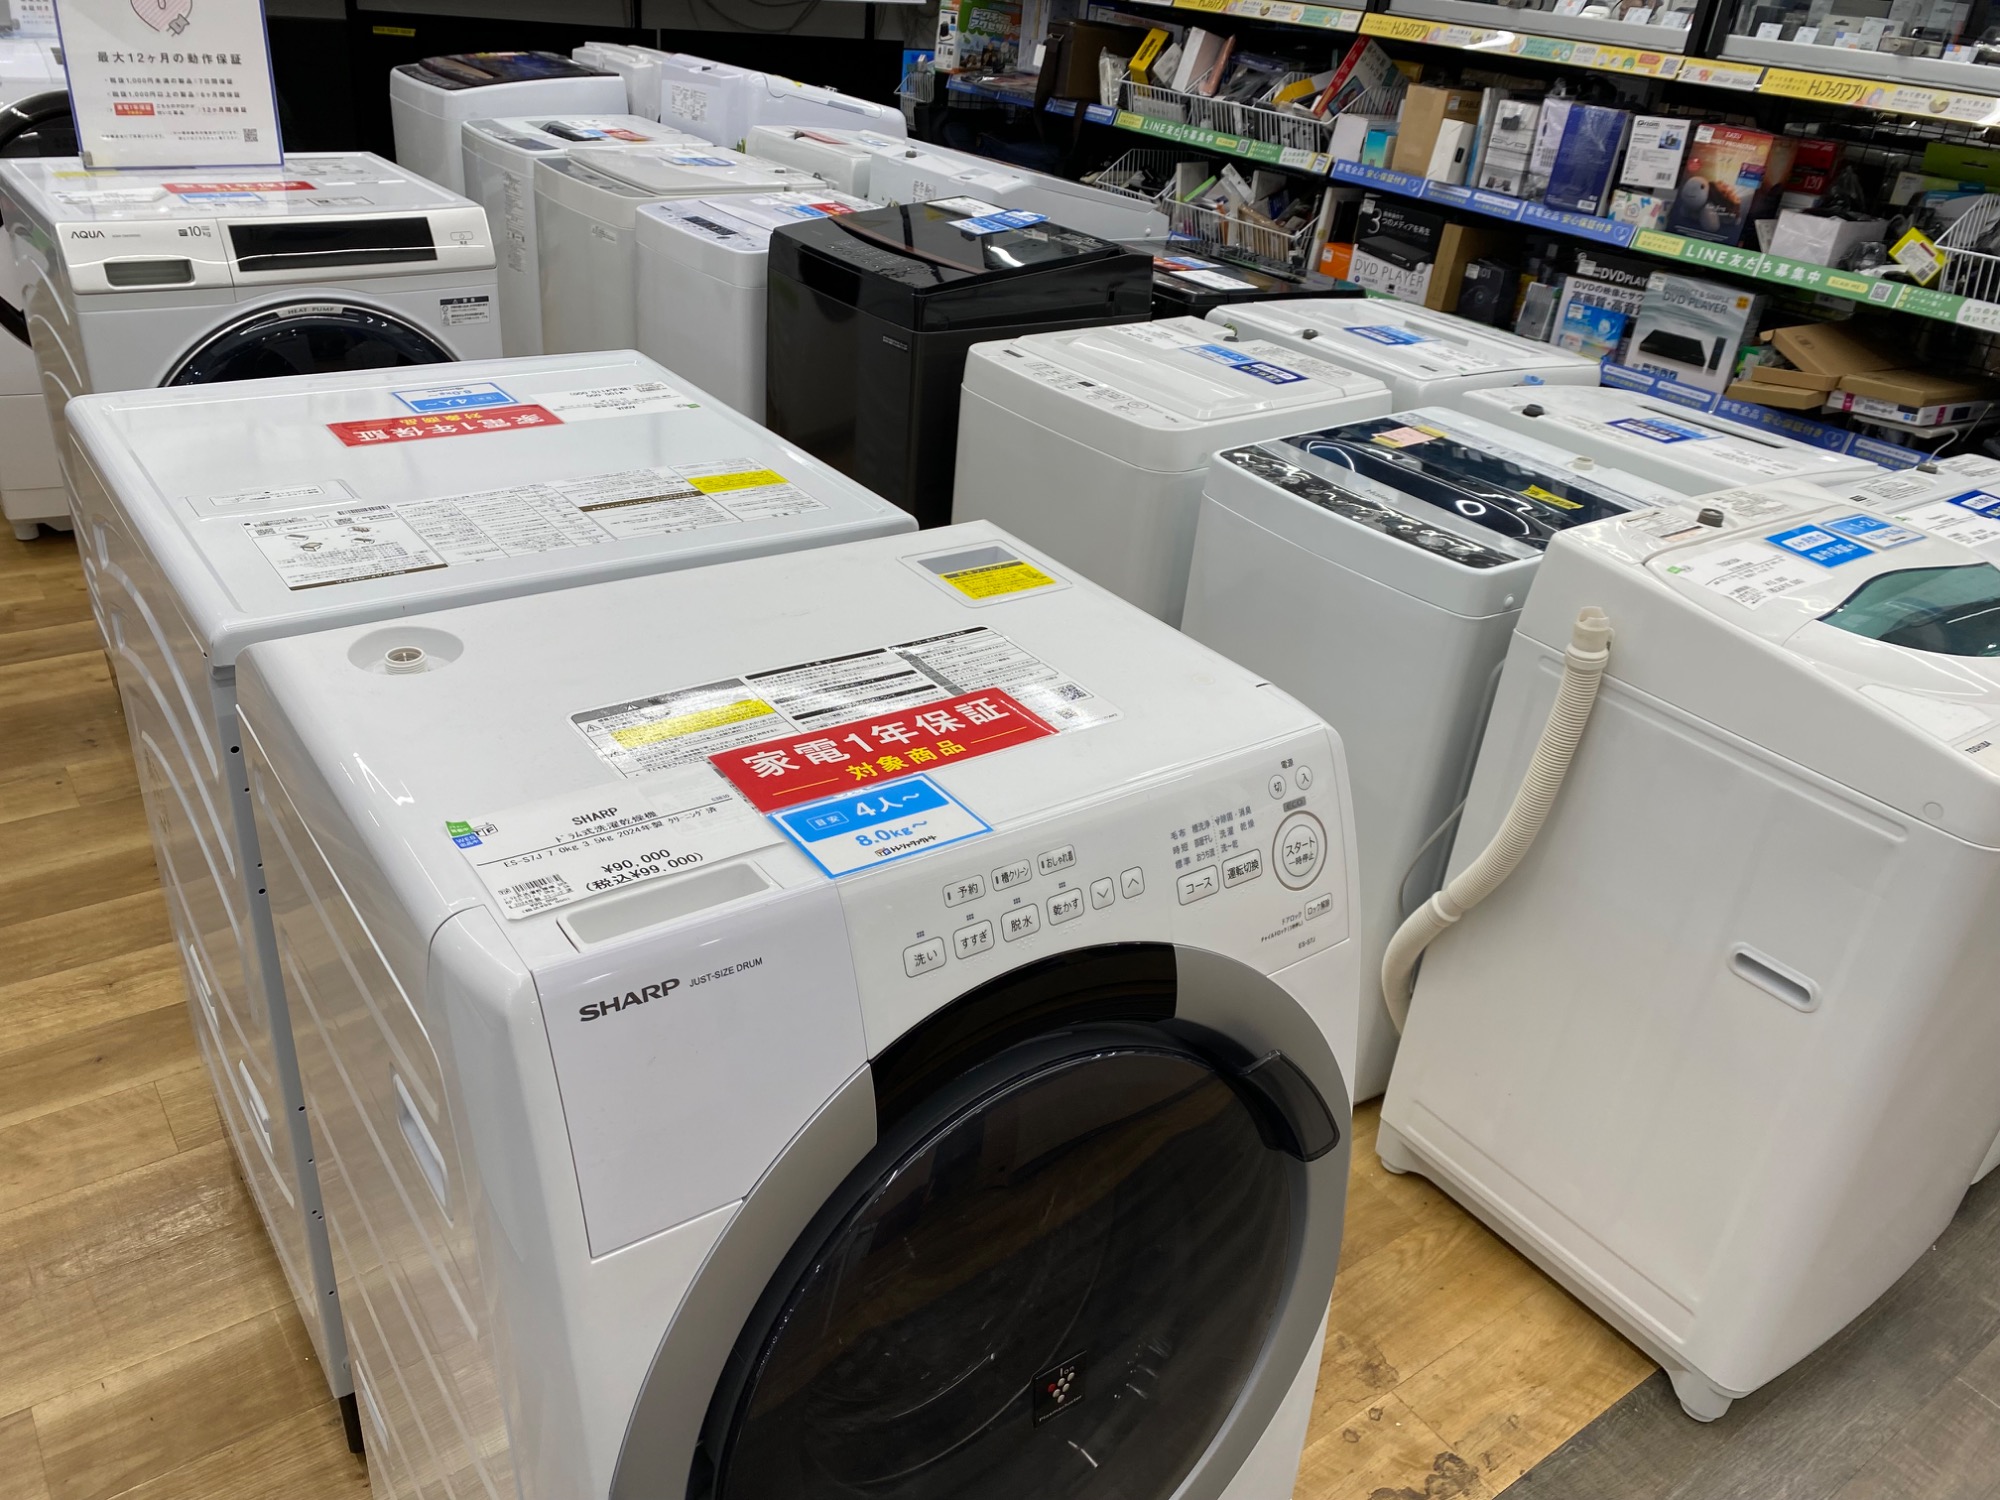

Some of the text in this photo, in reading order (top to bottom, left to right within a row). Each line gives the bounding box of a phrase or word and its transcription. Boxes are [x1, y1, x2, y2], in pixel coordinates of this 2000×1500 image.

[98, 52, 242, 65] 最大12ヶ月の動作保証
[71, 230, 105, 239] AQUA
[1355, 259, 1378, 275] DVD
[1382, 266, 1424, 288] PLAYER
[1662, 291, 1728, 315] DVD PLAYER
[353, 412, 546, 443] 家電1年保証
[741, 697, 1011, 779] 家電1年保証
[845, 740, 967, 781] 対象商品
[1273, 781, 1282, 792] 切
[571, 806, 618, 826] SHARP
[815, 813, 841, 827] 目安
[503, 853, 543, 868] ES-S7J
[584, 834, 614, 848] 3.5kg
[617, 820, 663, 838] 2024年製
[1285, 835, 1316, 857] スタート
[585, 851, 704, 892] (税込¥99,000)
[601, 848, 671, 875] ¥90,000
[957, 850, 1074, 897] 予約 槽クリーン おしゃれ着
[1186, 859, 1259, 895] コース 運転切換
[914, 897, 1079, 968] 洗い すすぎ 脱水 乾かす
[689, 957, 763, 987] JUST-SIZE DRUM
[579, 978, 680, 1022] SHARP
